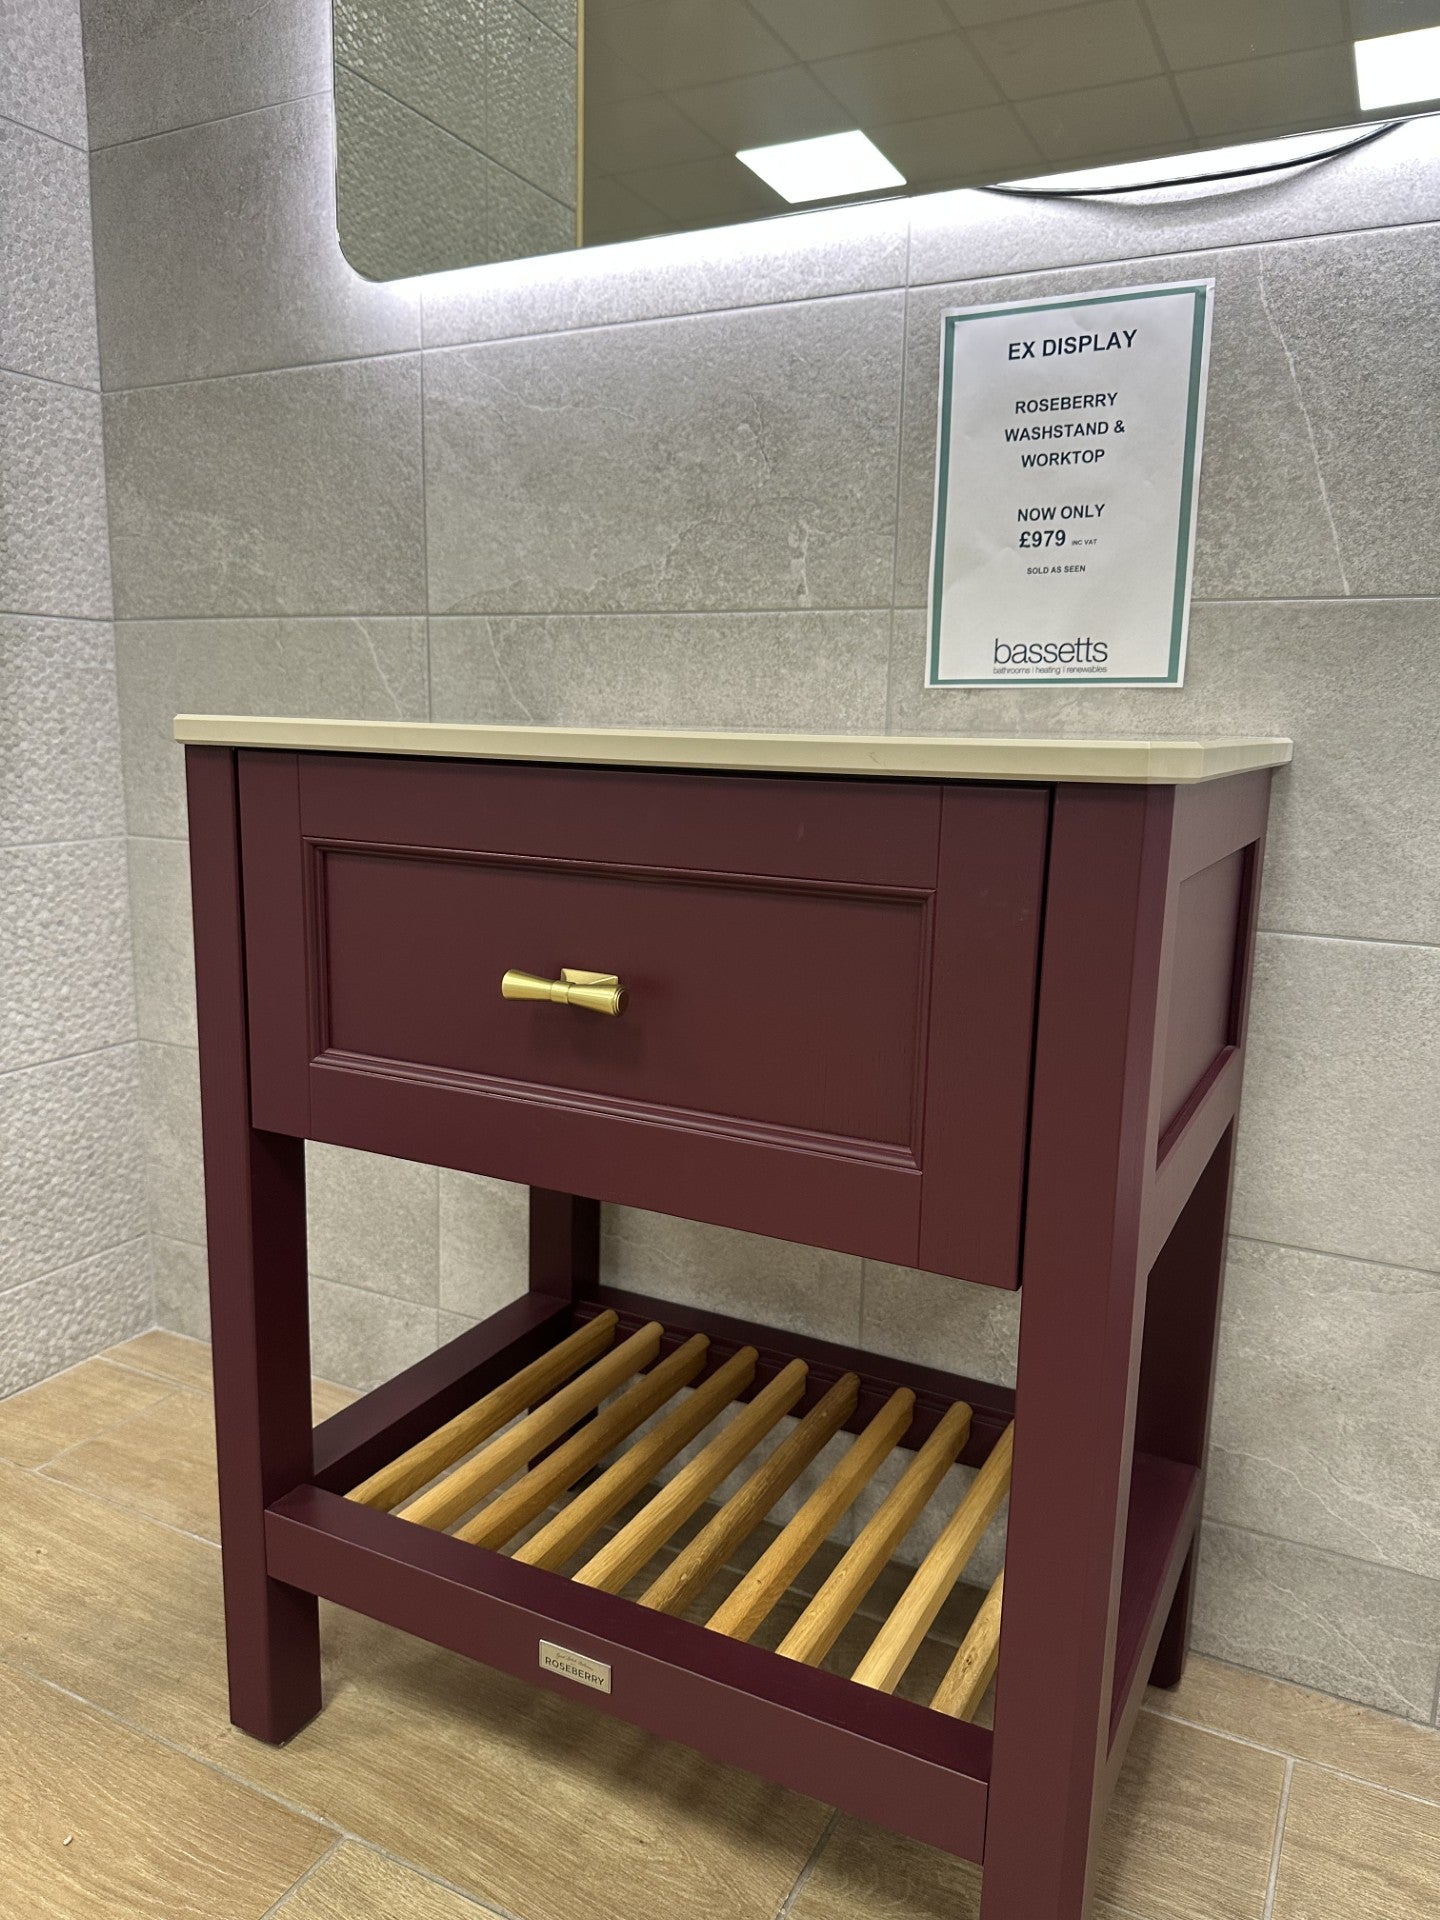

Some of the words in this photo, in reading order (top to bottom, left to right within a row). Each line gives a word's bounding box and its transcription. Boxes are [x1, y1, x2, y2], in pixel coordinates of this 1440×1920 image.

[1008, 341, 1036, 361] EX
[1042, 329, 1138, 358] DISPLAY
[1015, 392, 1119, 415] ROSEBERRY
[1004, 421, 1109, 443] WASHSTAND
[1113, 419, 1126, 434] &
[1020, 448, 1106, 469] WORKTOP
[1017, 507, 1057, 523] NOW
[1060, 503, 1106, 520] ONLY
[1018, 529, 1067, 549] £979
[1083, 538, 1098, 546] VAT
[1026, 566, 1050, 575] SOLD
[1050, 565, 1062, 574] AS
[1063, 564, 1087, 574] SEEN
[993, 637, 1109, 665] bassetts
[993, 667, 1031, 675] bathrooms
[1035, 667, 1060, 676] heating
[1066, 665, 1108, 674] renewables
[545, 1656, 604, 1686] ROSEBERRY
